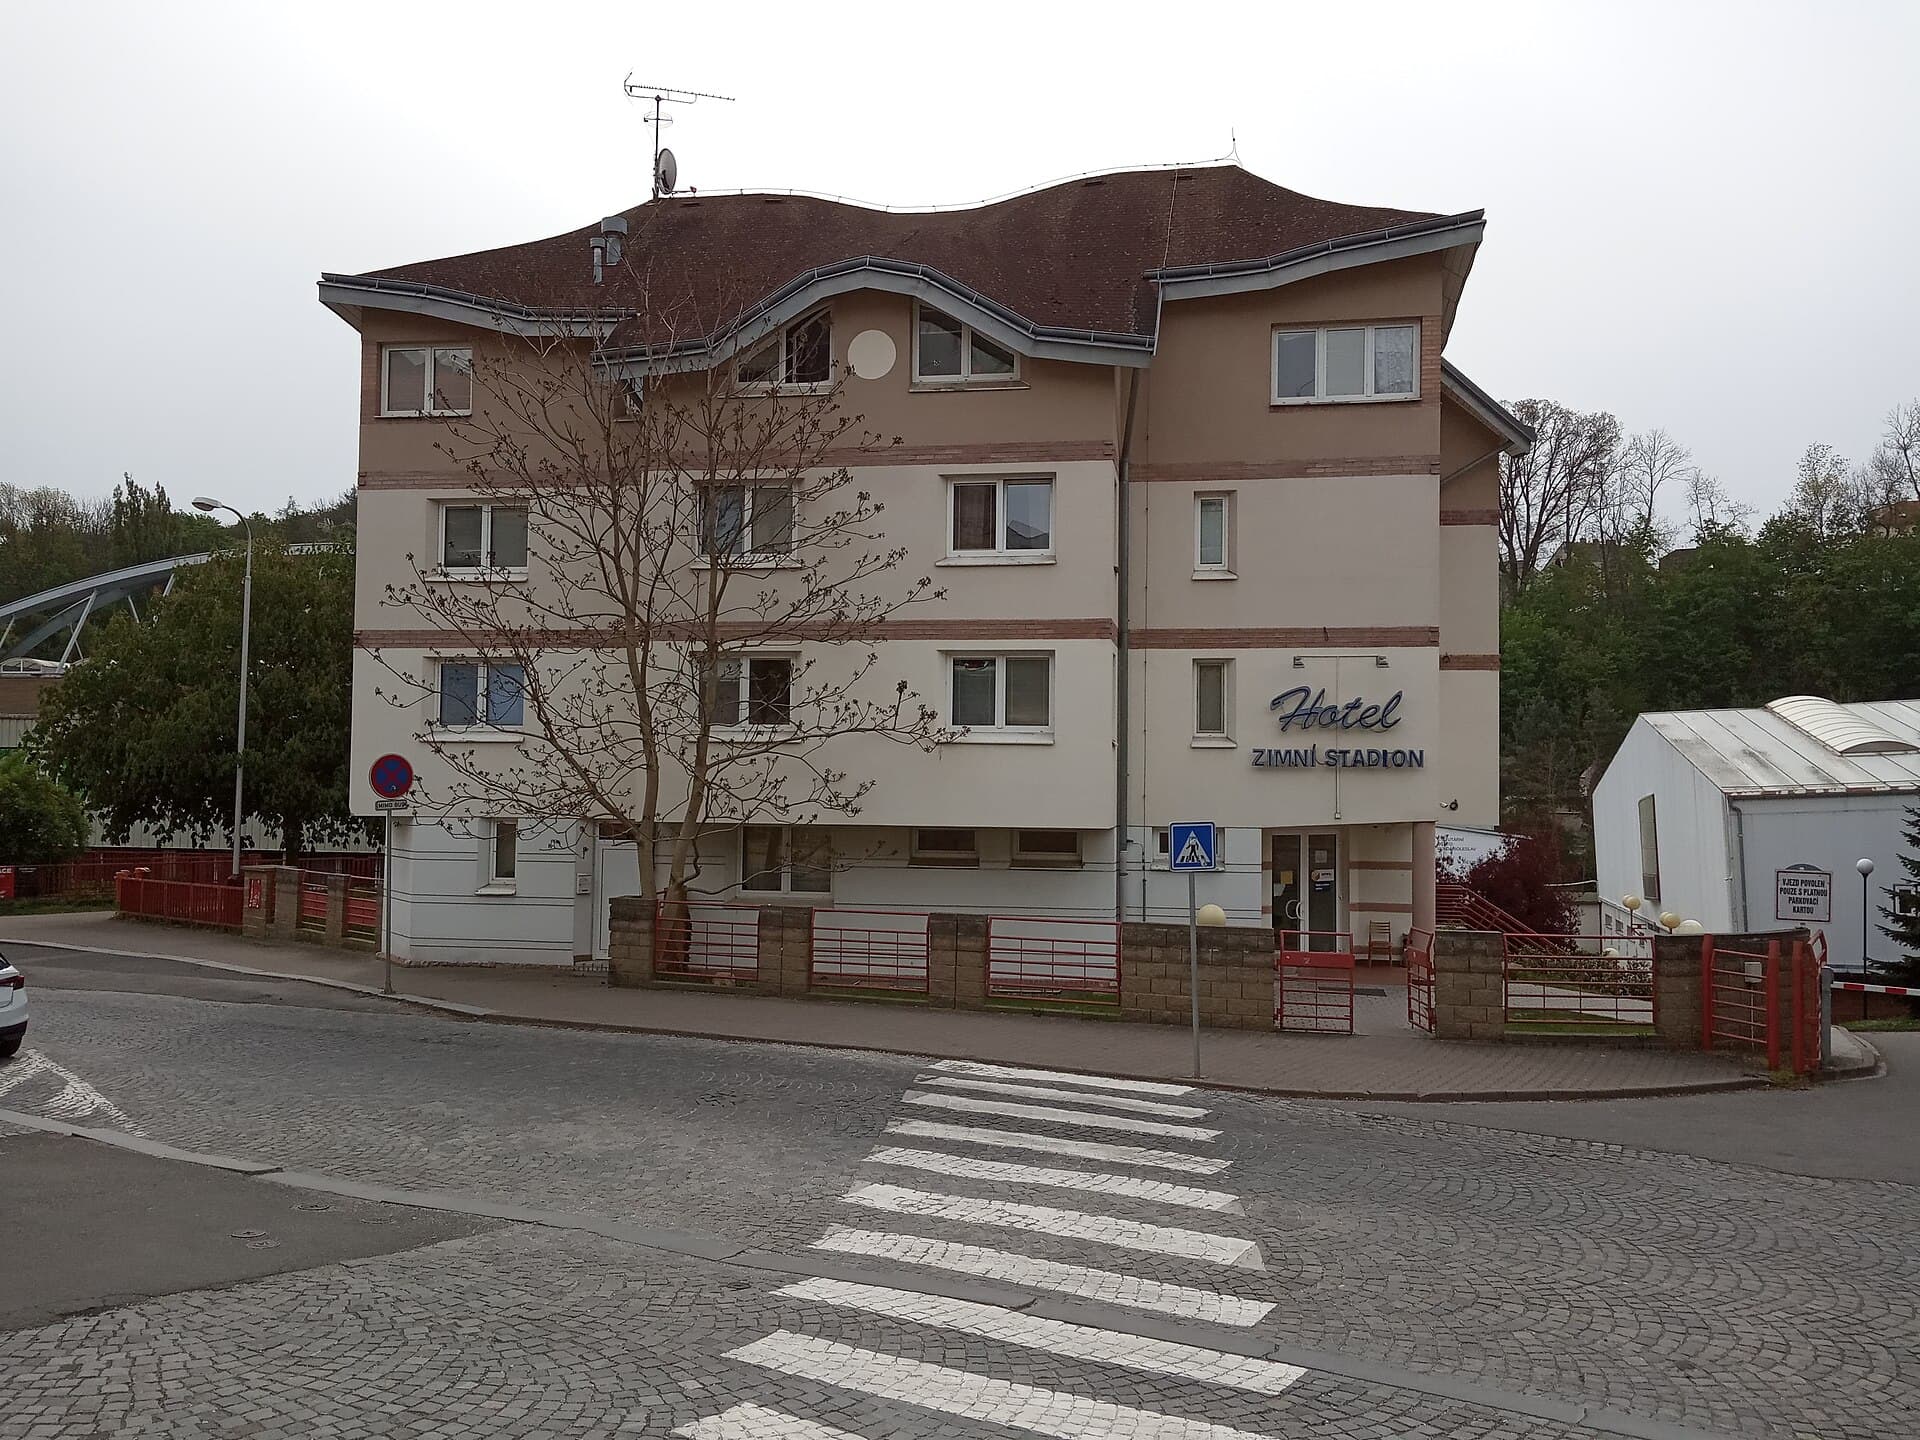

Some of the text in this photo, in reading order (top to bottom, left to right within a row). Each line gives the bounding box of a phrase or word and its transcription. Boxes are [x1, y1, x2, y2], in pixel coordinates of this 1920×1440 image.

[1270, 685, 1403, 732] Hotel
[1252, 744, 1425, 769] ZIMNÍ STADION
[1782, 878, 1825, 888] VJEZD POVOLEN
[1780, 887, 1828, 897] POUZE S PLATNOU
[1792, 906, 1814, 914] KARTOU
